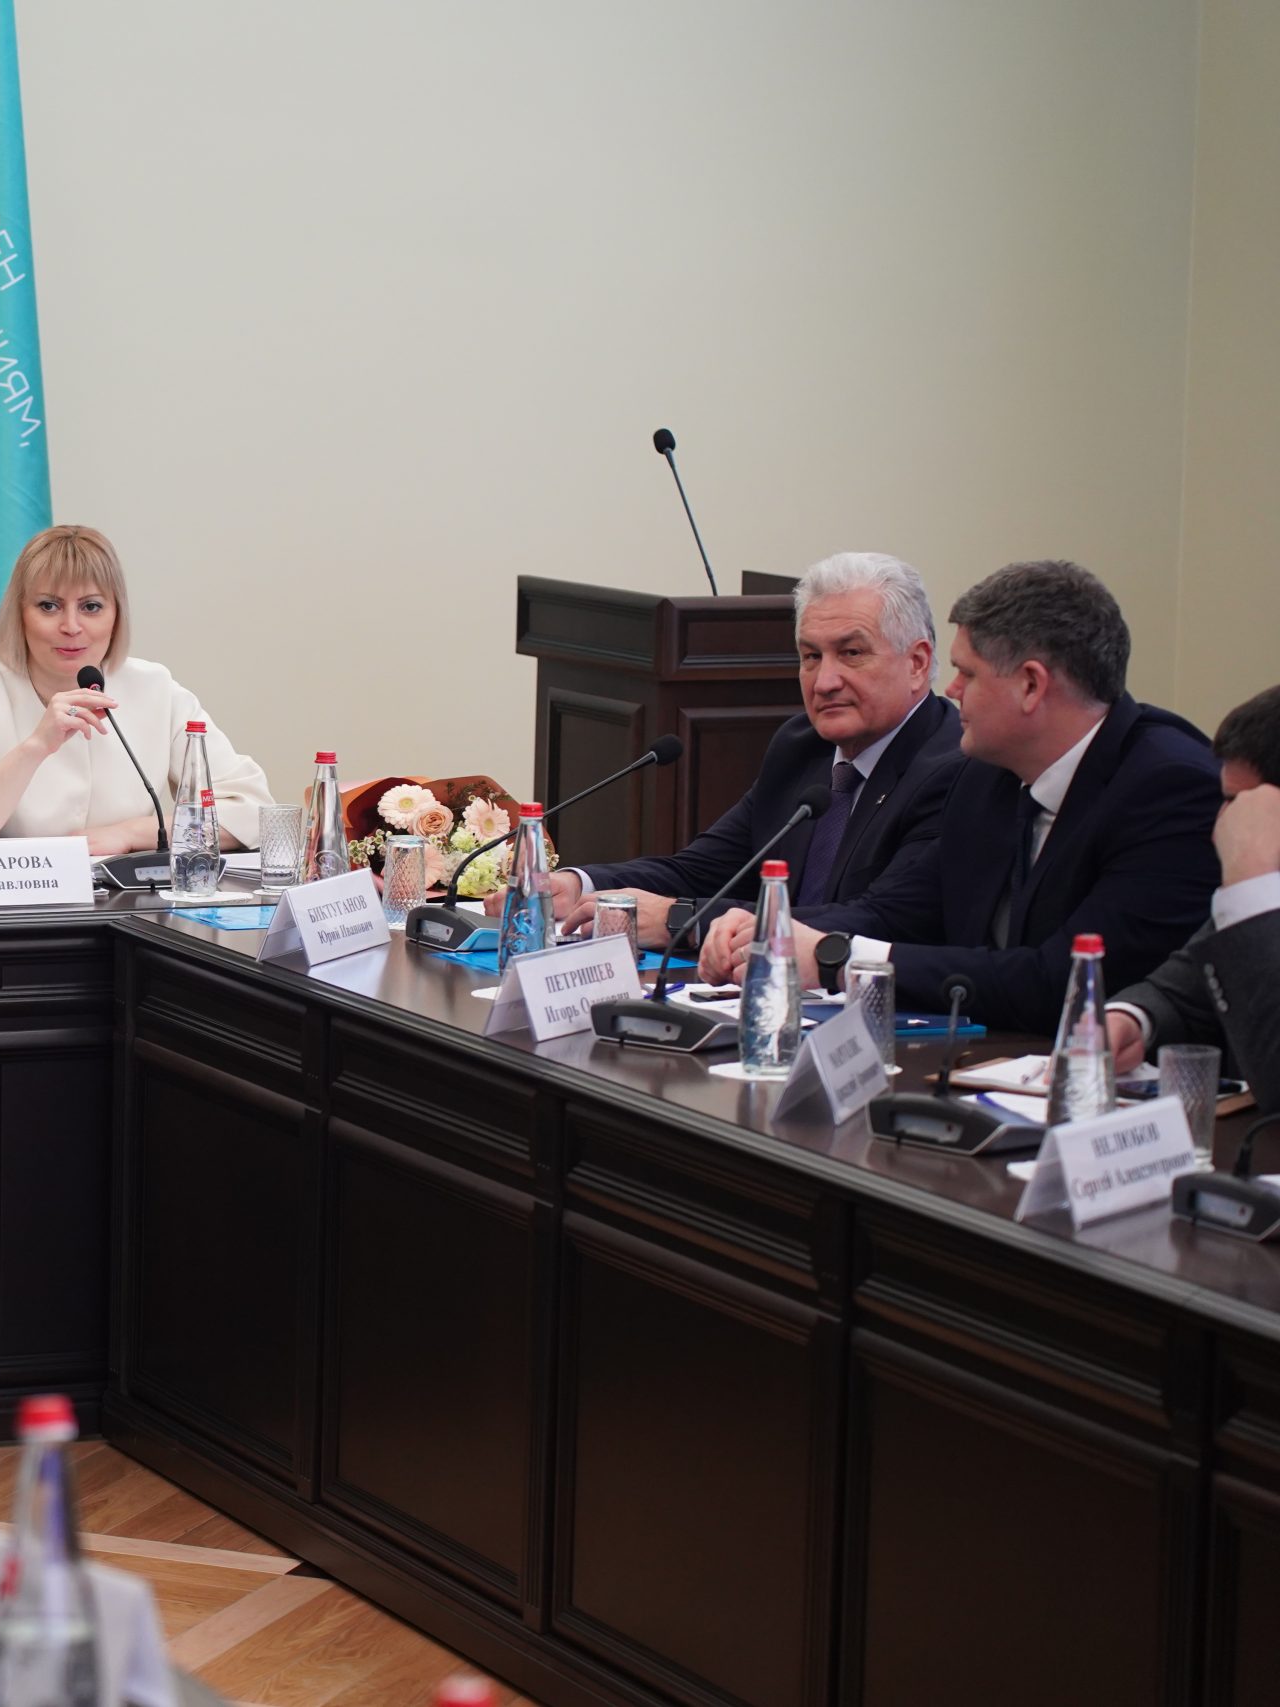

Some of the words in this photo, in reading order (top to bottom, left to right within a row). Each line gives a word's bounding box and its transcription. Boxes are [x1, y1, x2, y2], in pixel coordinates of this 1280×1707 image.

[306, 894, 368, 923] БИКТУГАНОВ
[316, 927, 341, 946] Юрий
[339, 920, 374, 938] Иванович
[544, 961, 615, 994] ПЕТРИЩЕВ
[544, 1004, 580, 1024] Игорь
